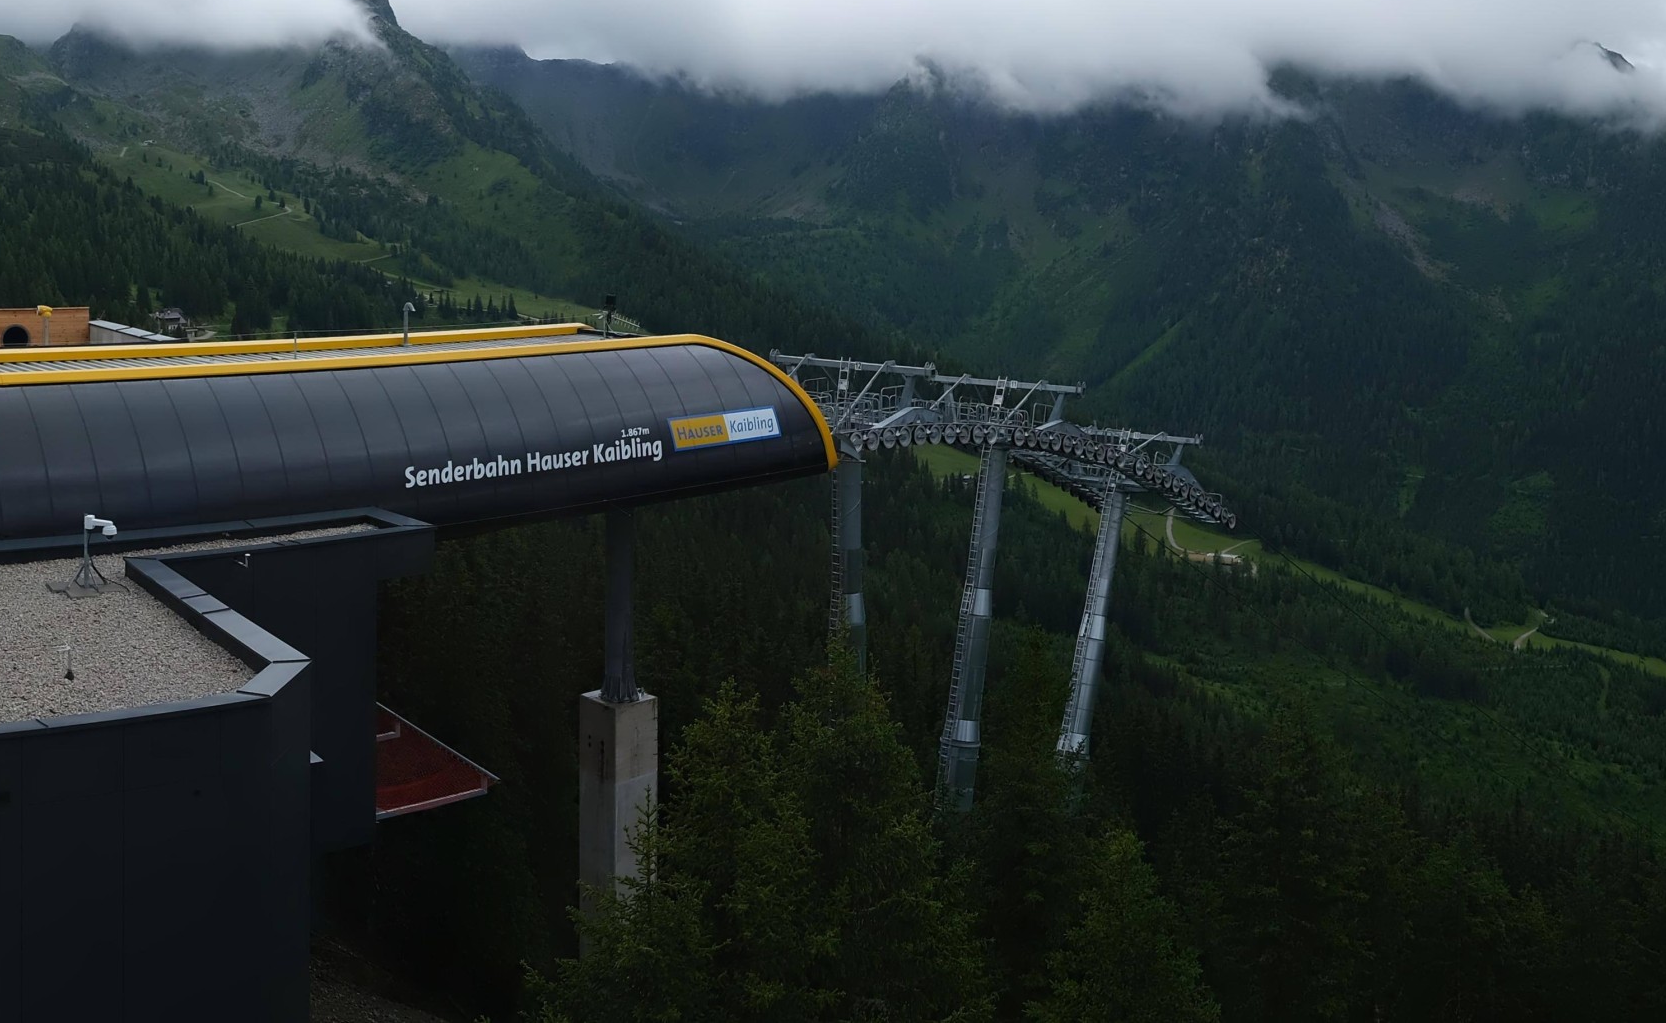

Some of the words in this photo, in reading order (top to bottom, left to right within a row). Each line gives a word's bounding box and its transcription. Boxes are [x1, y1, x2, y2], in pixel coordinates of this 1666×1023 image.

[621, 427, 650, 439] 1.867m
[676, 423, 724, 441] HAUSER
[730, 414, 774, 434] Kaibling
[405, 454, 522, 489] Senderbahn
[527, 448, 589, 473] Hauser
[593, 438, 663, 463] Kaibling
